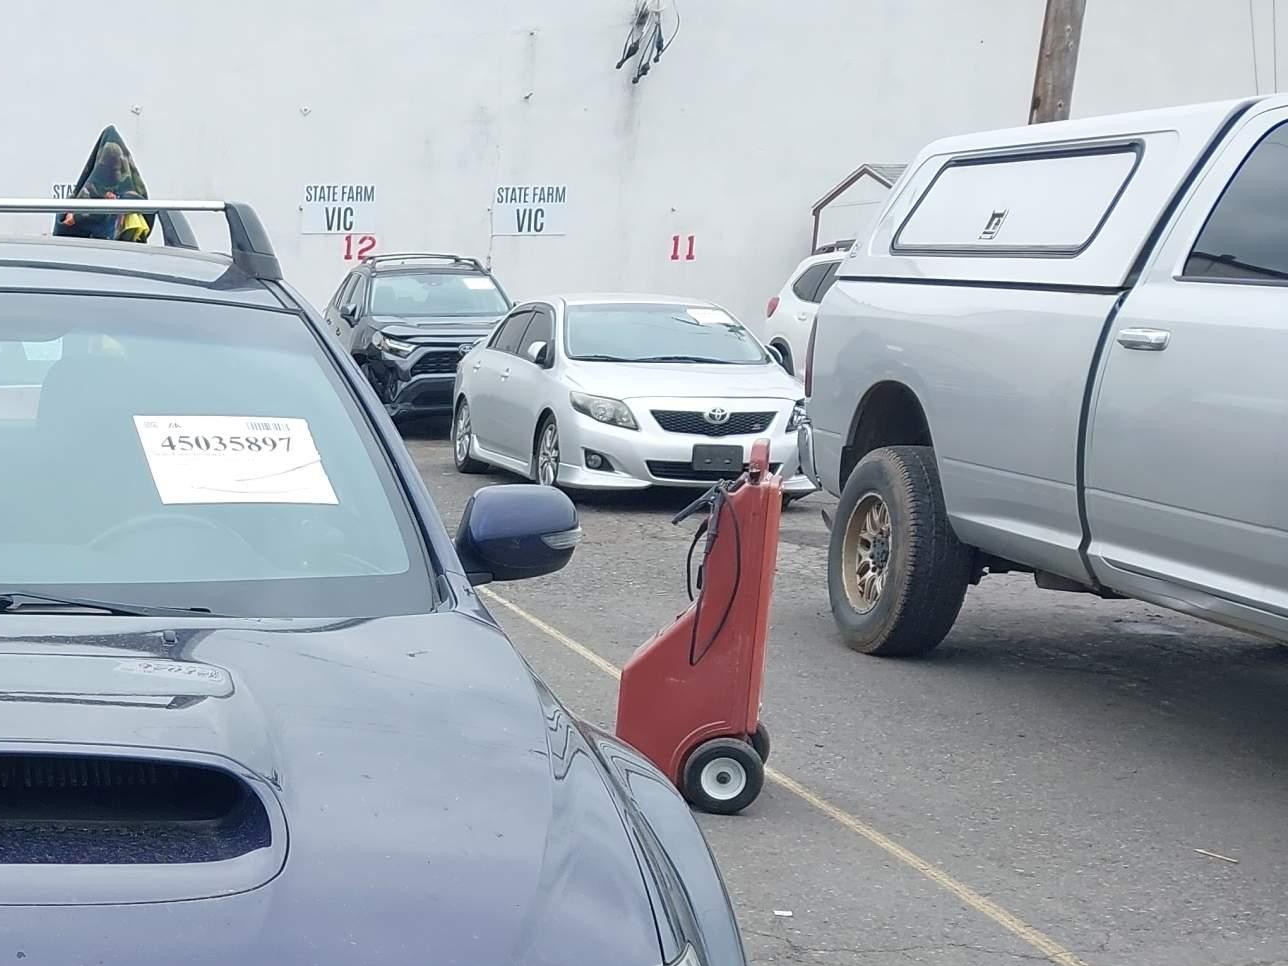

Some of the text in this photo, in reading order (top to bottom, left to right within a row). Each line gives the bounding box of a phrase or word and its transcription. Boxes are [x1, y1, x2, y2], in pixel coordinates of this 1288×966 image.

[53, 184, 78, 199] STA
[306, 185, 375, 202] STATE FARM
[497, 186, 566, 203] STATE FARM
[325, 206, 353, 231] VIC
[516, 208, 544, 232] VIC
[344, 235, 376, 261] 12
[671, 235, 695, 260] 11
[161, 435, 292, 453] 45035897
